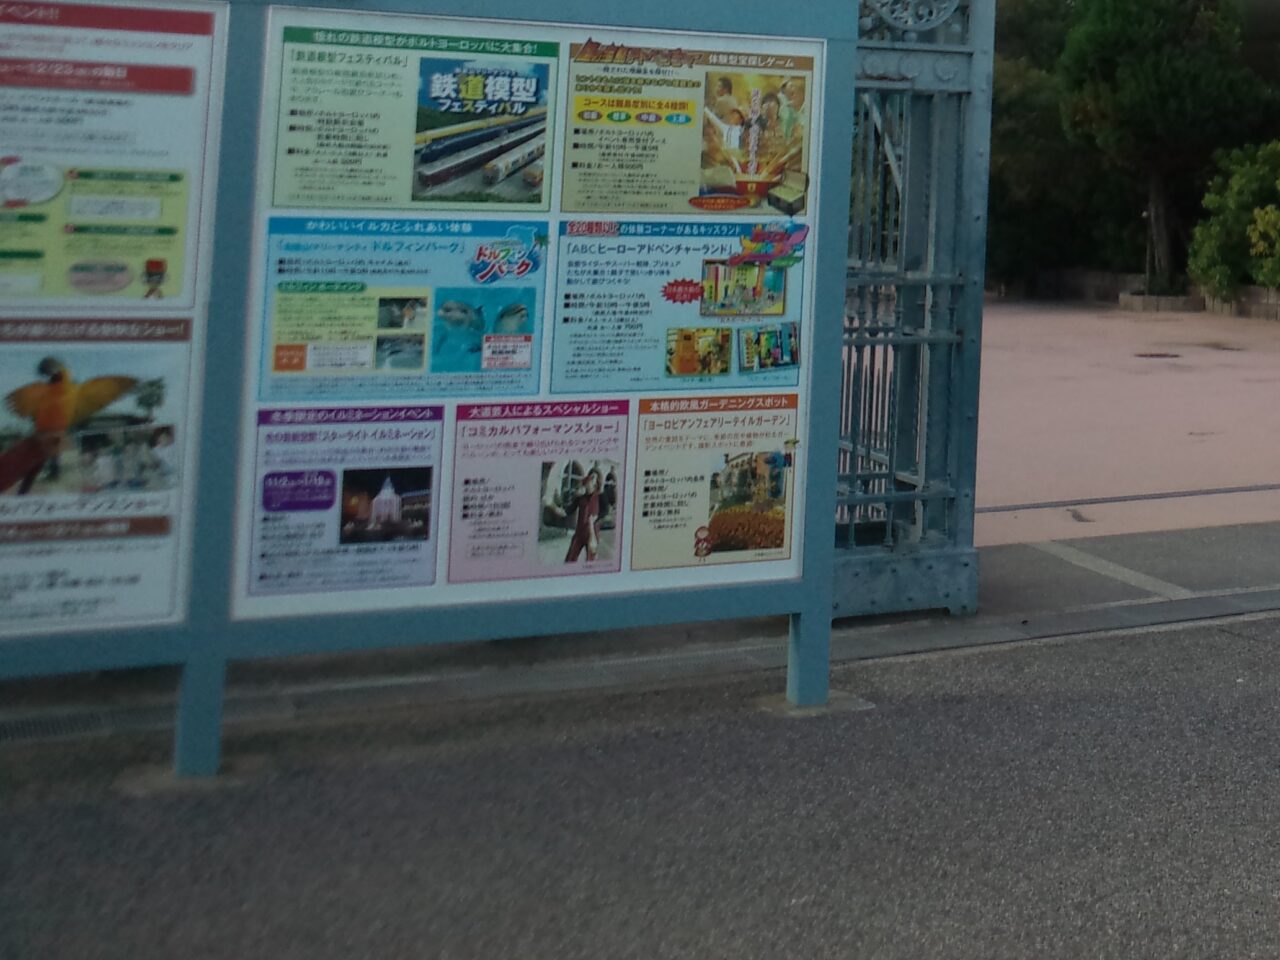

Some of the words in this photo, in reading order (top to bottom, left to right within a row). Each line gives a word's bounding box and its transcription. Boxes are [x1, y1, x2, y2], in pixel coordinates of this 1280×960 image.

[430, 72, 539, 103] 鉄道模型
[439, 99, 527, 115] フェスティバル
[468, 404, 620, 418] 大道芸人によるスペシャルショー
[649, 399, 788, 412] 本格的欧風ガーデニングスポット
[461, 421, 620, 438] 「コミカルパフォーマンスショー」
[643, 415, 790, 431] 「ヨーロピアンフェアリーテイルガーデン」
